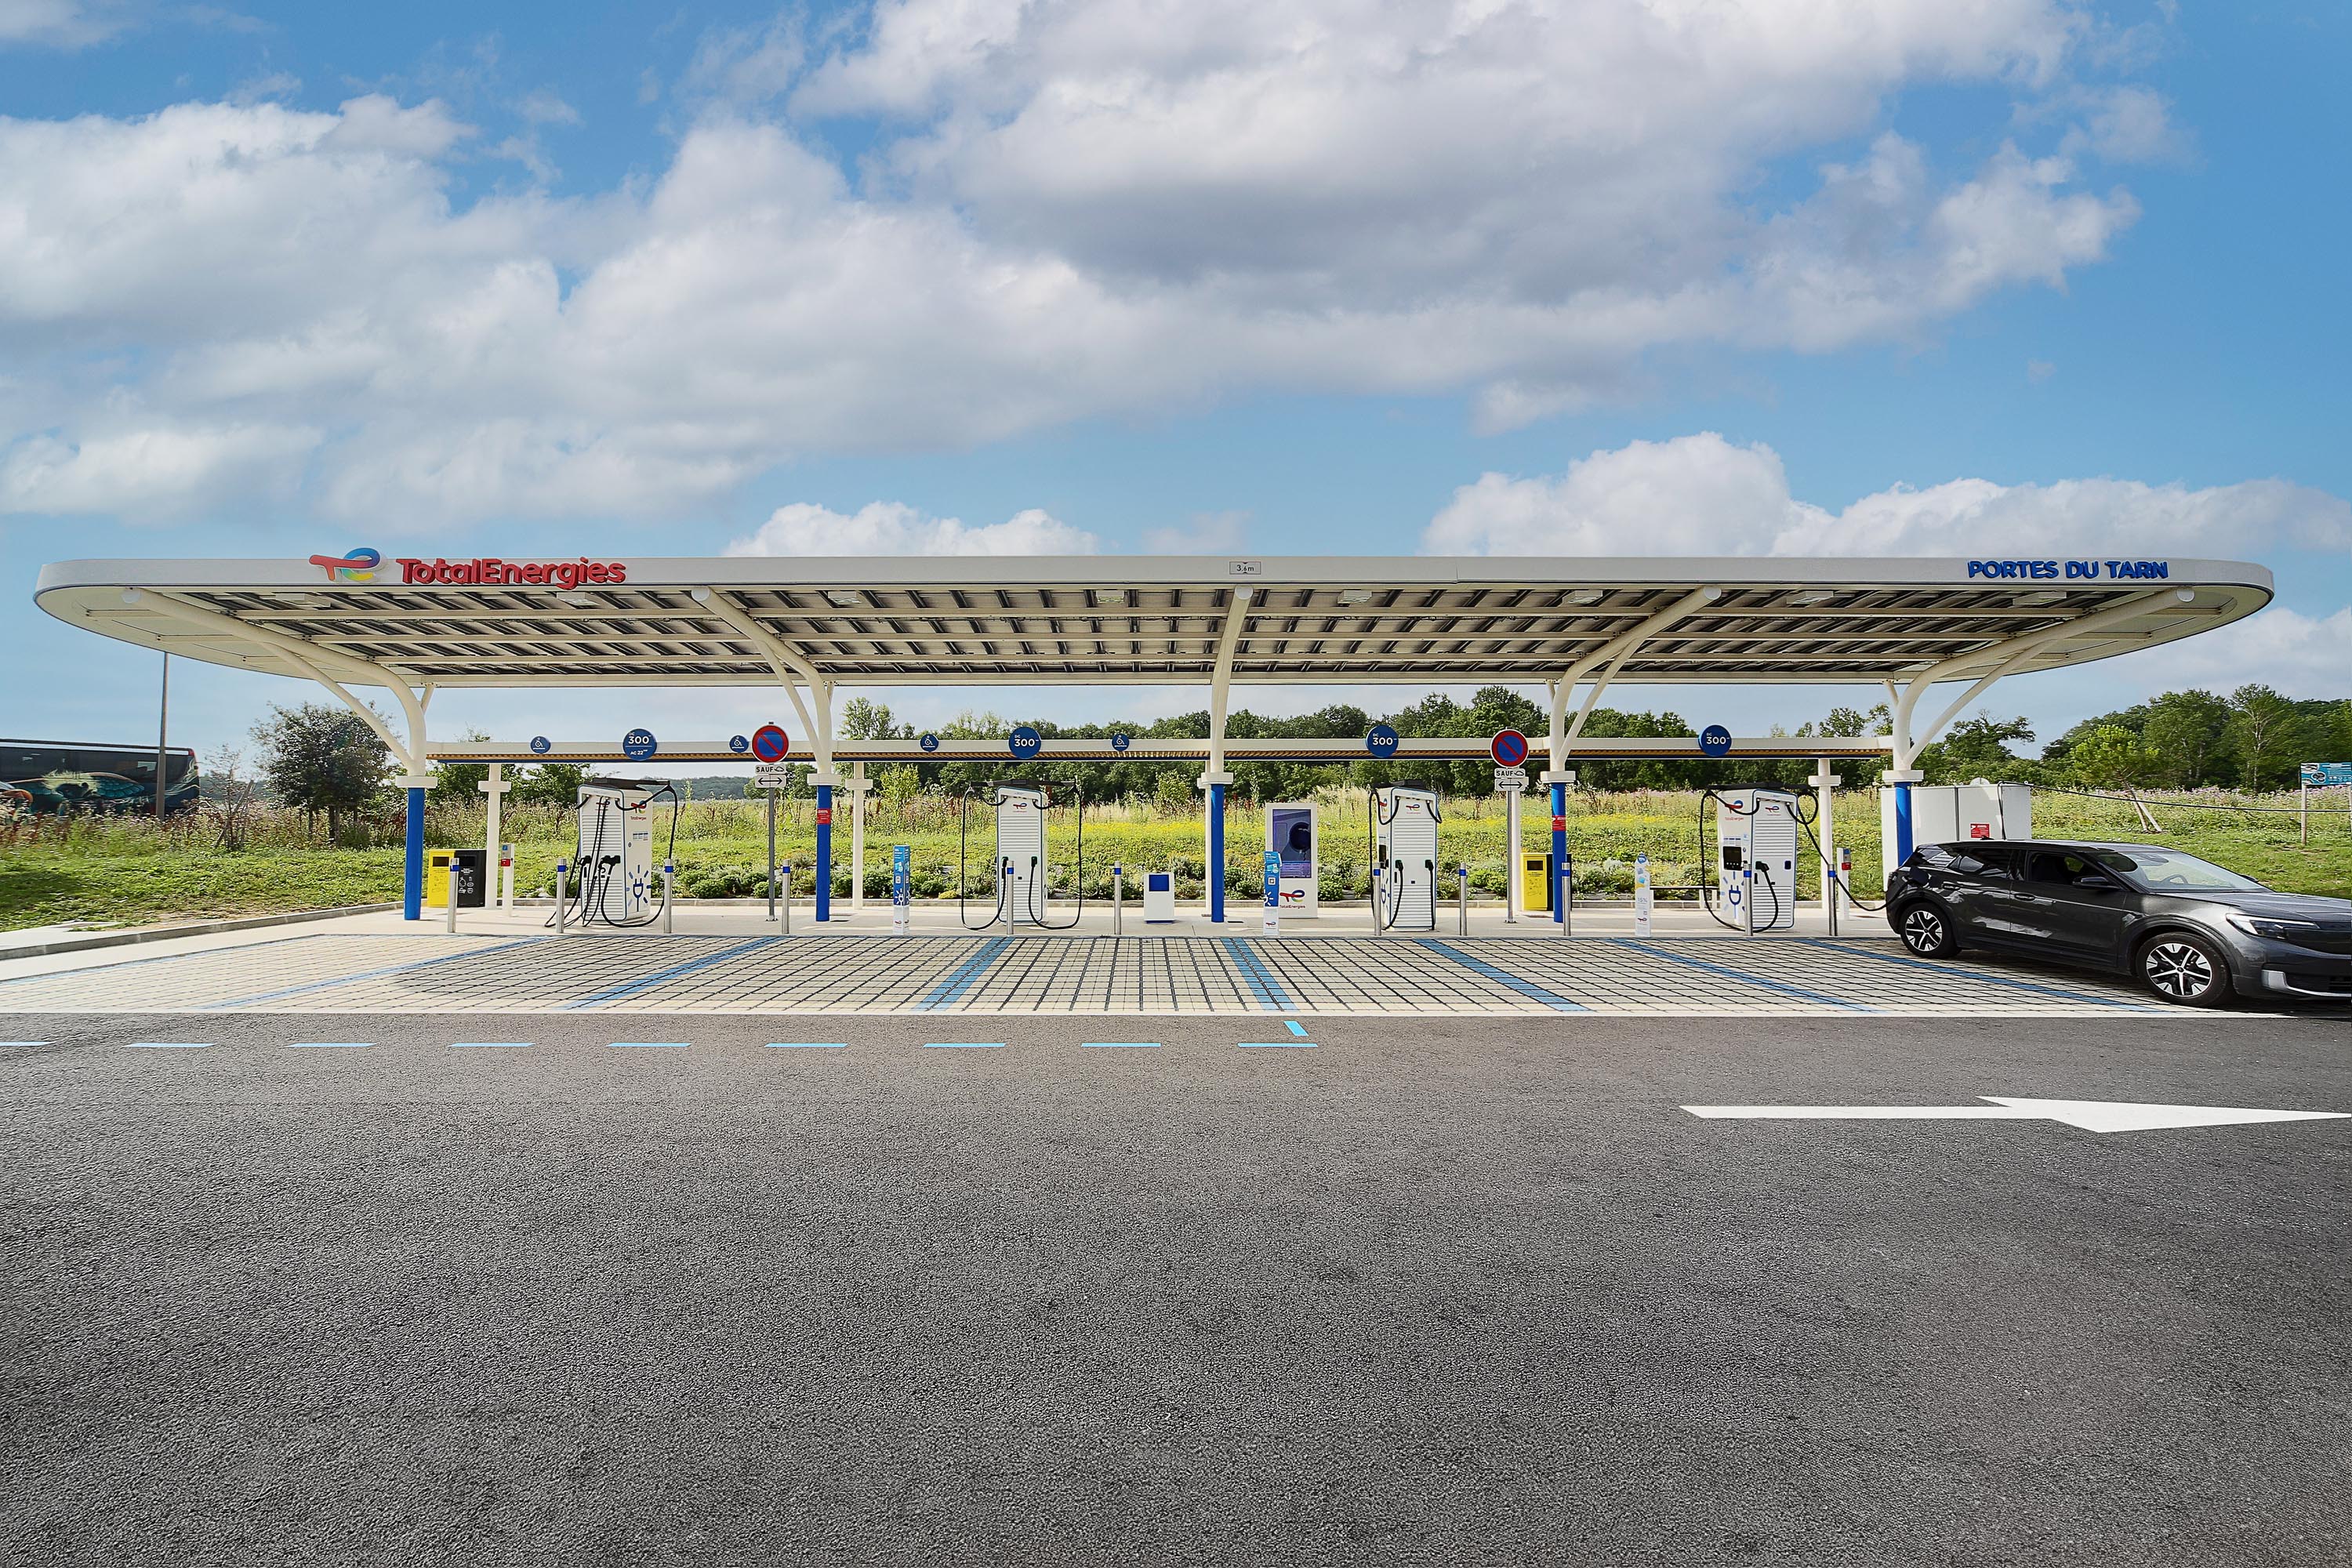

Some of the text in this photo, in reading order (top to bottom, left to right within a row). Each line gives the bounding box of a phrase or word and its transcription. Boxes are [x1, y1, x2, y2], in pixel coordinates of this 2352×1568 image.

[396, 557, 626, 590] TotalEnergies
[1967, 561, 2169, 579] PORTES DU TARN
[1373, 737, 1393, 746] 300
[1706, 736, 1726, 745] 300
